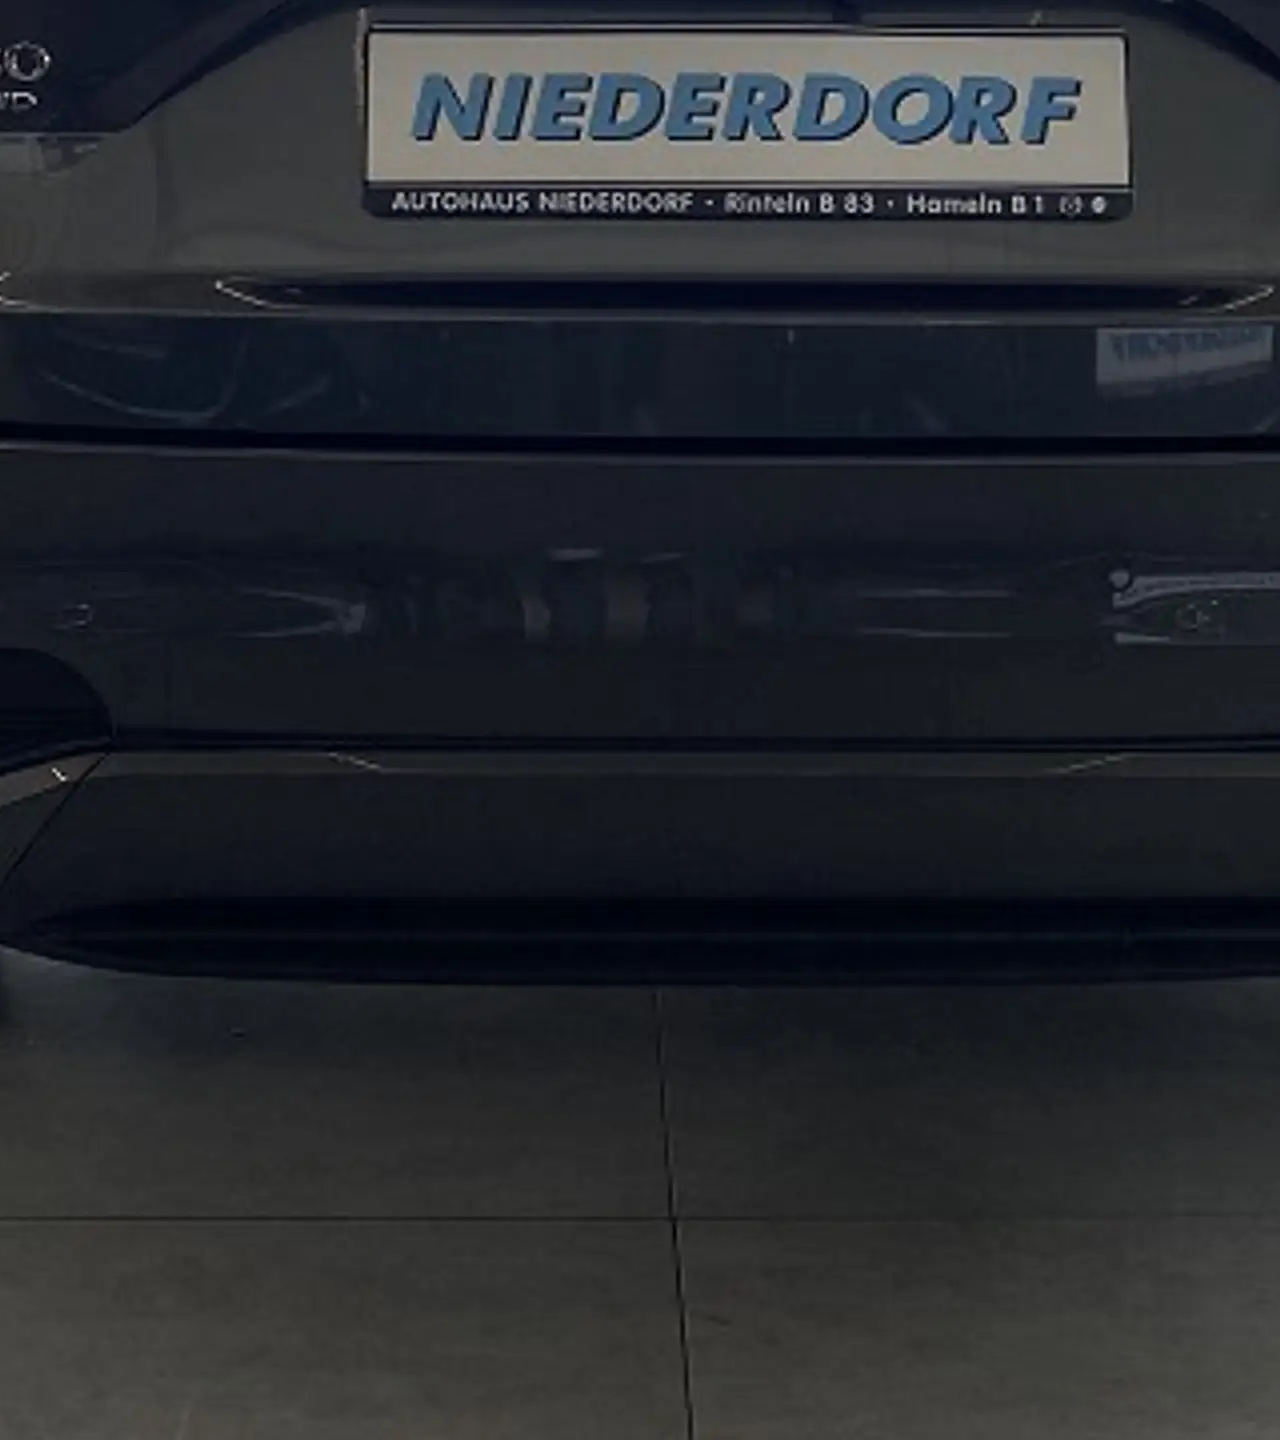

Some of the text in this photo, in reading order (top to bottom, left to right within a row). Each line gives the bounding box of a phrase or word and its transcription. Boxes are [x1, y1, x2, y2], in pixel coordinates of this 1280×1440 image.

[410, 72, 1082, 146] NIEDERDORF
[391, 191, 1045, 215] AUTOHAUS NIEDERDORF Rinteln B 83 Hameln B 1
